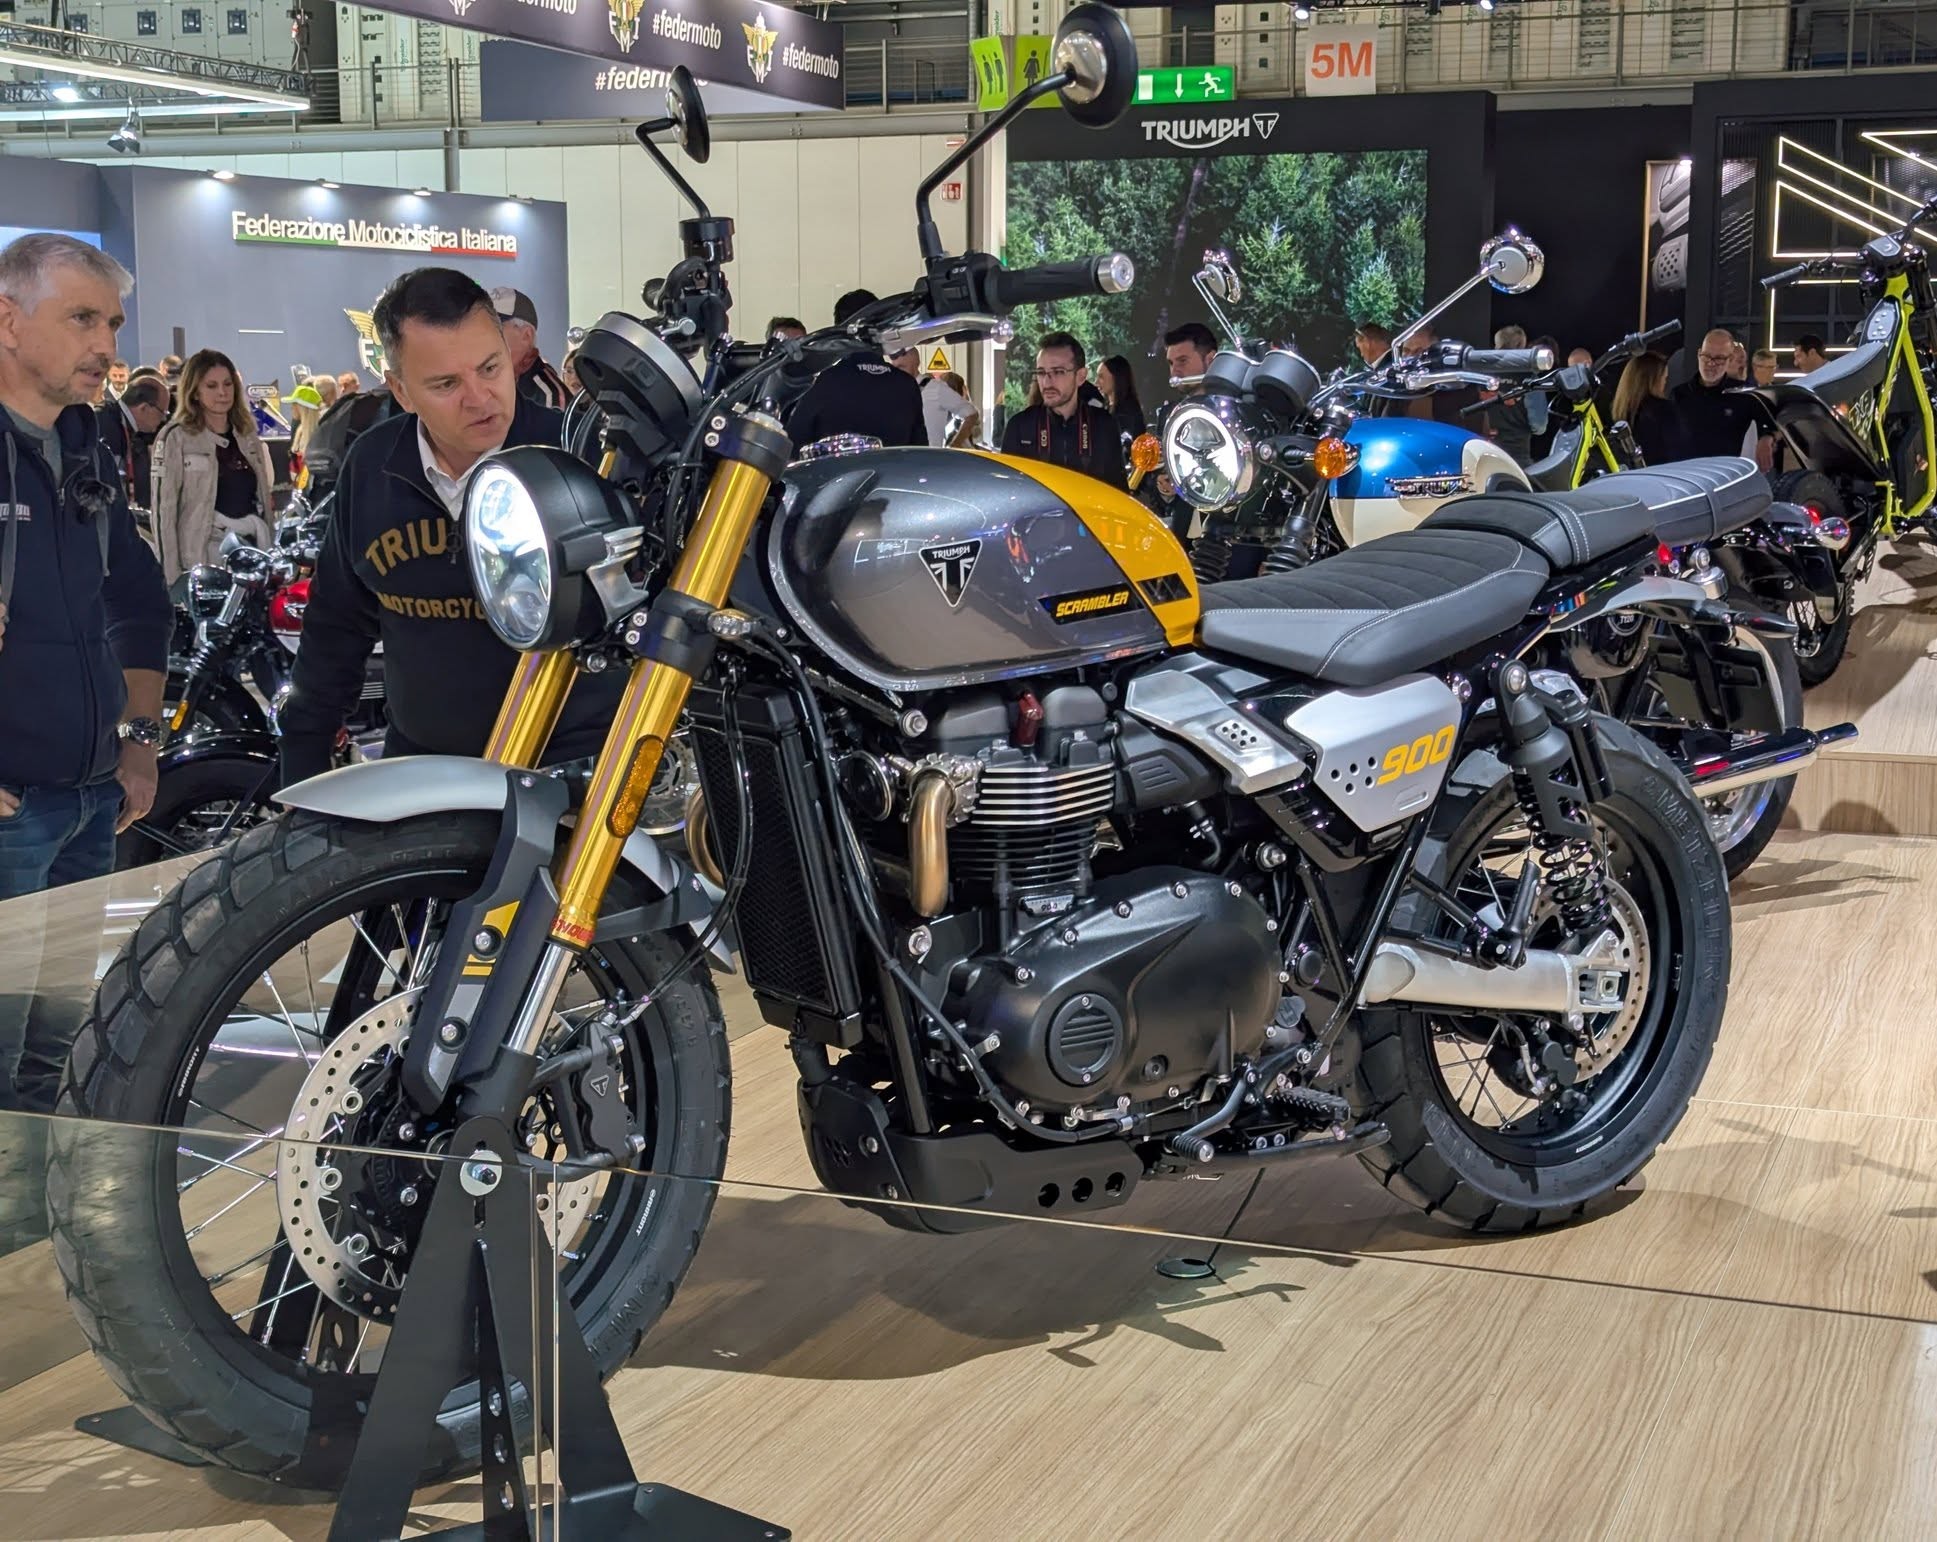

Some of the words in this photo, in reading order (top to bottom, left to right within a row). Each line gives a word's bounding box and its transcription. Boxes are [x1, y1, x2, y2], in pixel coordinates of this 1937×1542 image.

[652, 8, 722, 50] #federmoto
[782, 42, 840, 80] #federmoto
[1311, 42, 1373, 79] 5M
[1141, 117, 1250, 149] TRIUMPH
[231, 210, 346, 242] Federazione
[349, 218, 458, 251] Motociclistica
[461, 227, 518, 253] Italiana
[365, 517, 448, 577] TRIU
[932, 545, 971, 561] TRIUMPH
[376, 591, 489, 620] MOTORCYC
[1055, 590, 1130, 618] SCRAMBLER
[1375, 723, 1456, 787] 900
